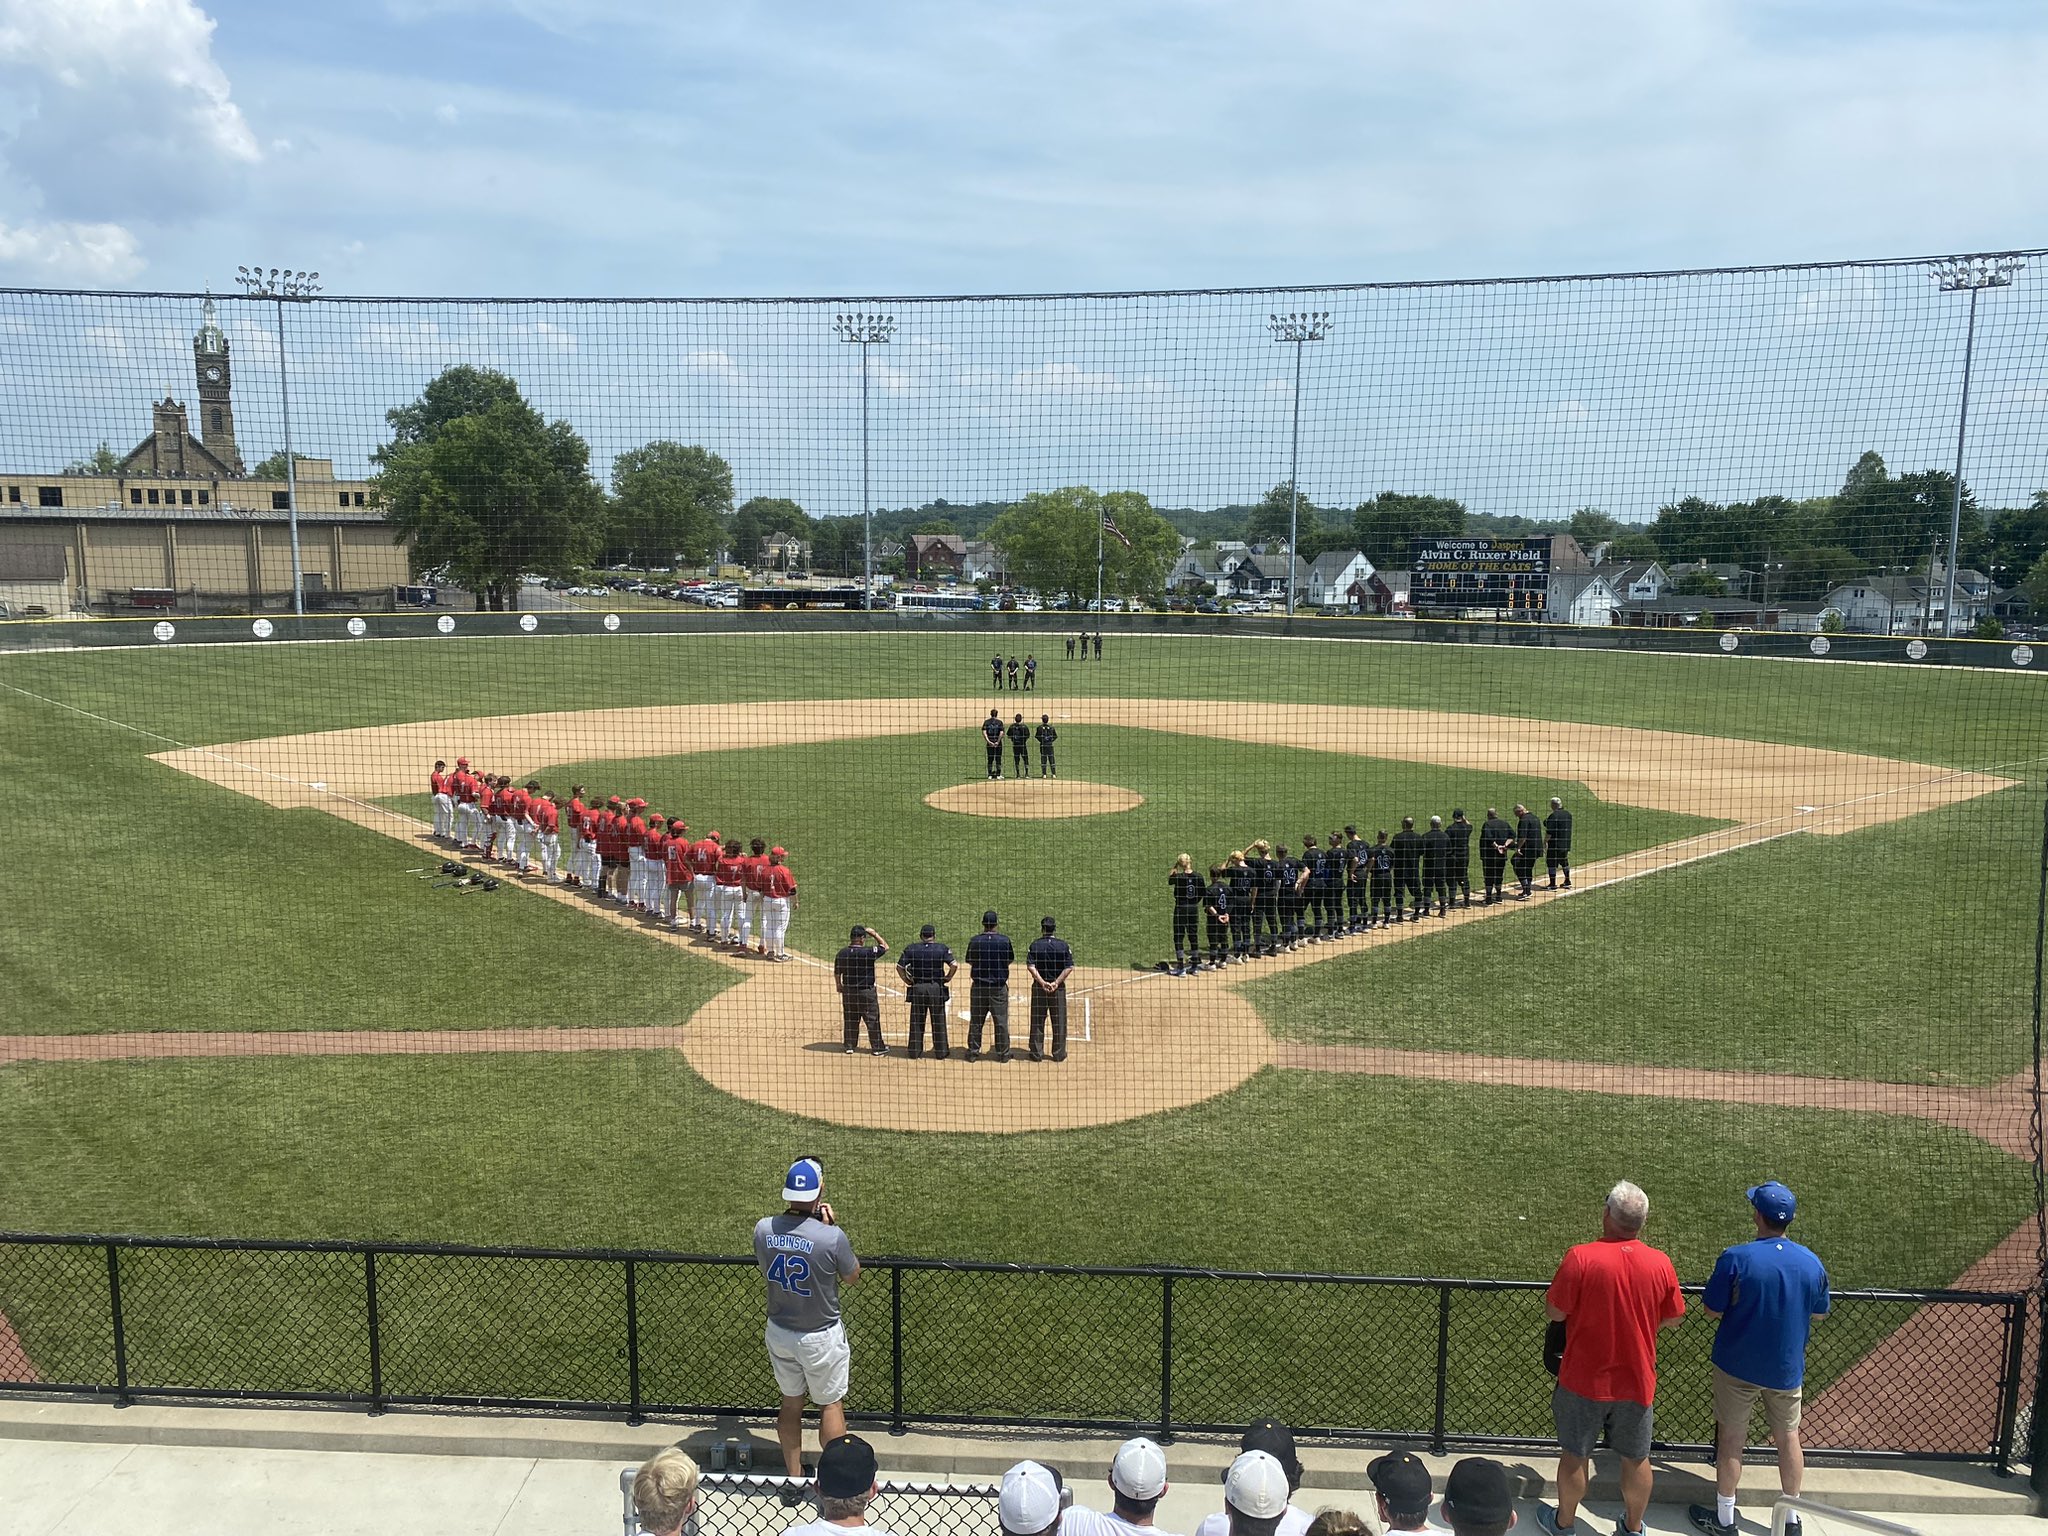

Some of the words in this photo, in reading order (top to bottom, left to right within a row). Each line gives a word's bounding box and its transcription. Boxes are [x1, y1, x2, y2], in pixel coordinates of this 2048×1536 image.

[1436, 541, 1475, 549] Welcome
[1479, 541, 1488, 549] to
[1491, 540, 1525, 551] Jasper's
[1420, 550, 1451, 559] Alvin
[1453, 550, 1465, 559] C.
[1468, 550, 1506, 559] Ruxer
[1510, 550, 1540, 559] Field
[1428, 562, 1458, 570] HOME
[1461, 562, 1476, 570] OF
[1478, 562, 1500, 570] THE
[1503, 562, 1531, 571] CATS
[1218, 893, 1227, 909] 4
[795, 1175, 806, 1187] C
[766, 1234, 814, 1254] ROBINSON
[767, 1253, 811, 1296] 42
